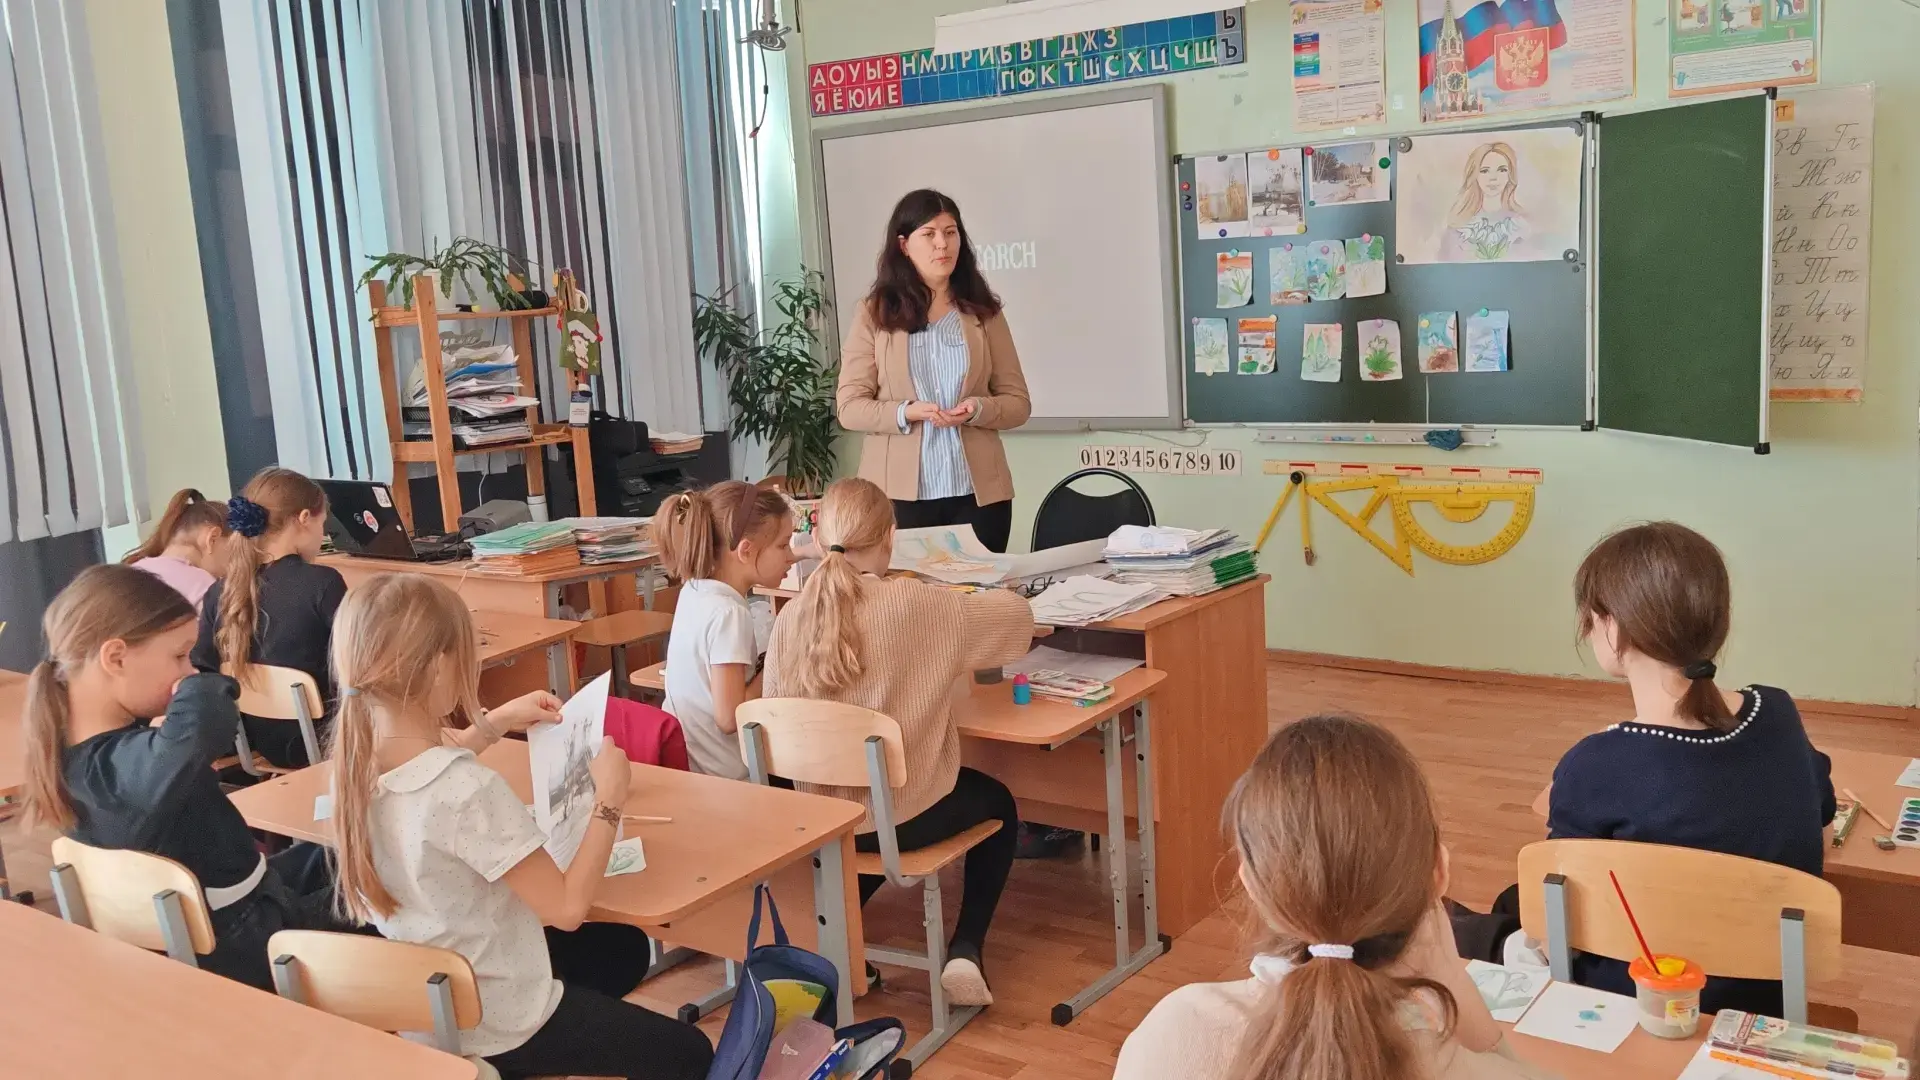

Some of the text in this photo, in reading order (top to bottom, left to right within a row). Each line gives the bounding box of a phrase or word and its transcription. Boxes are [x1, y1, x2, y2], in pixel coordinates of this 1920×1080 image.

[1080, 449, 1236, 471] 0 1 2 3 4 5 6 7 8 9 10
